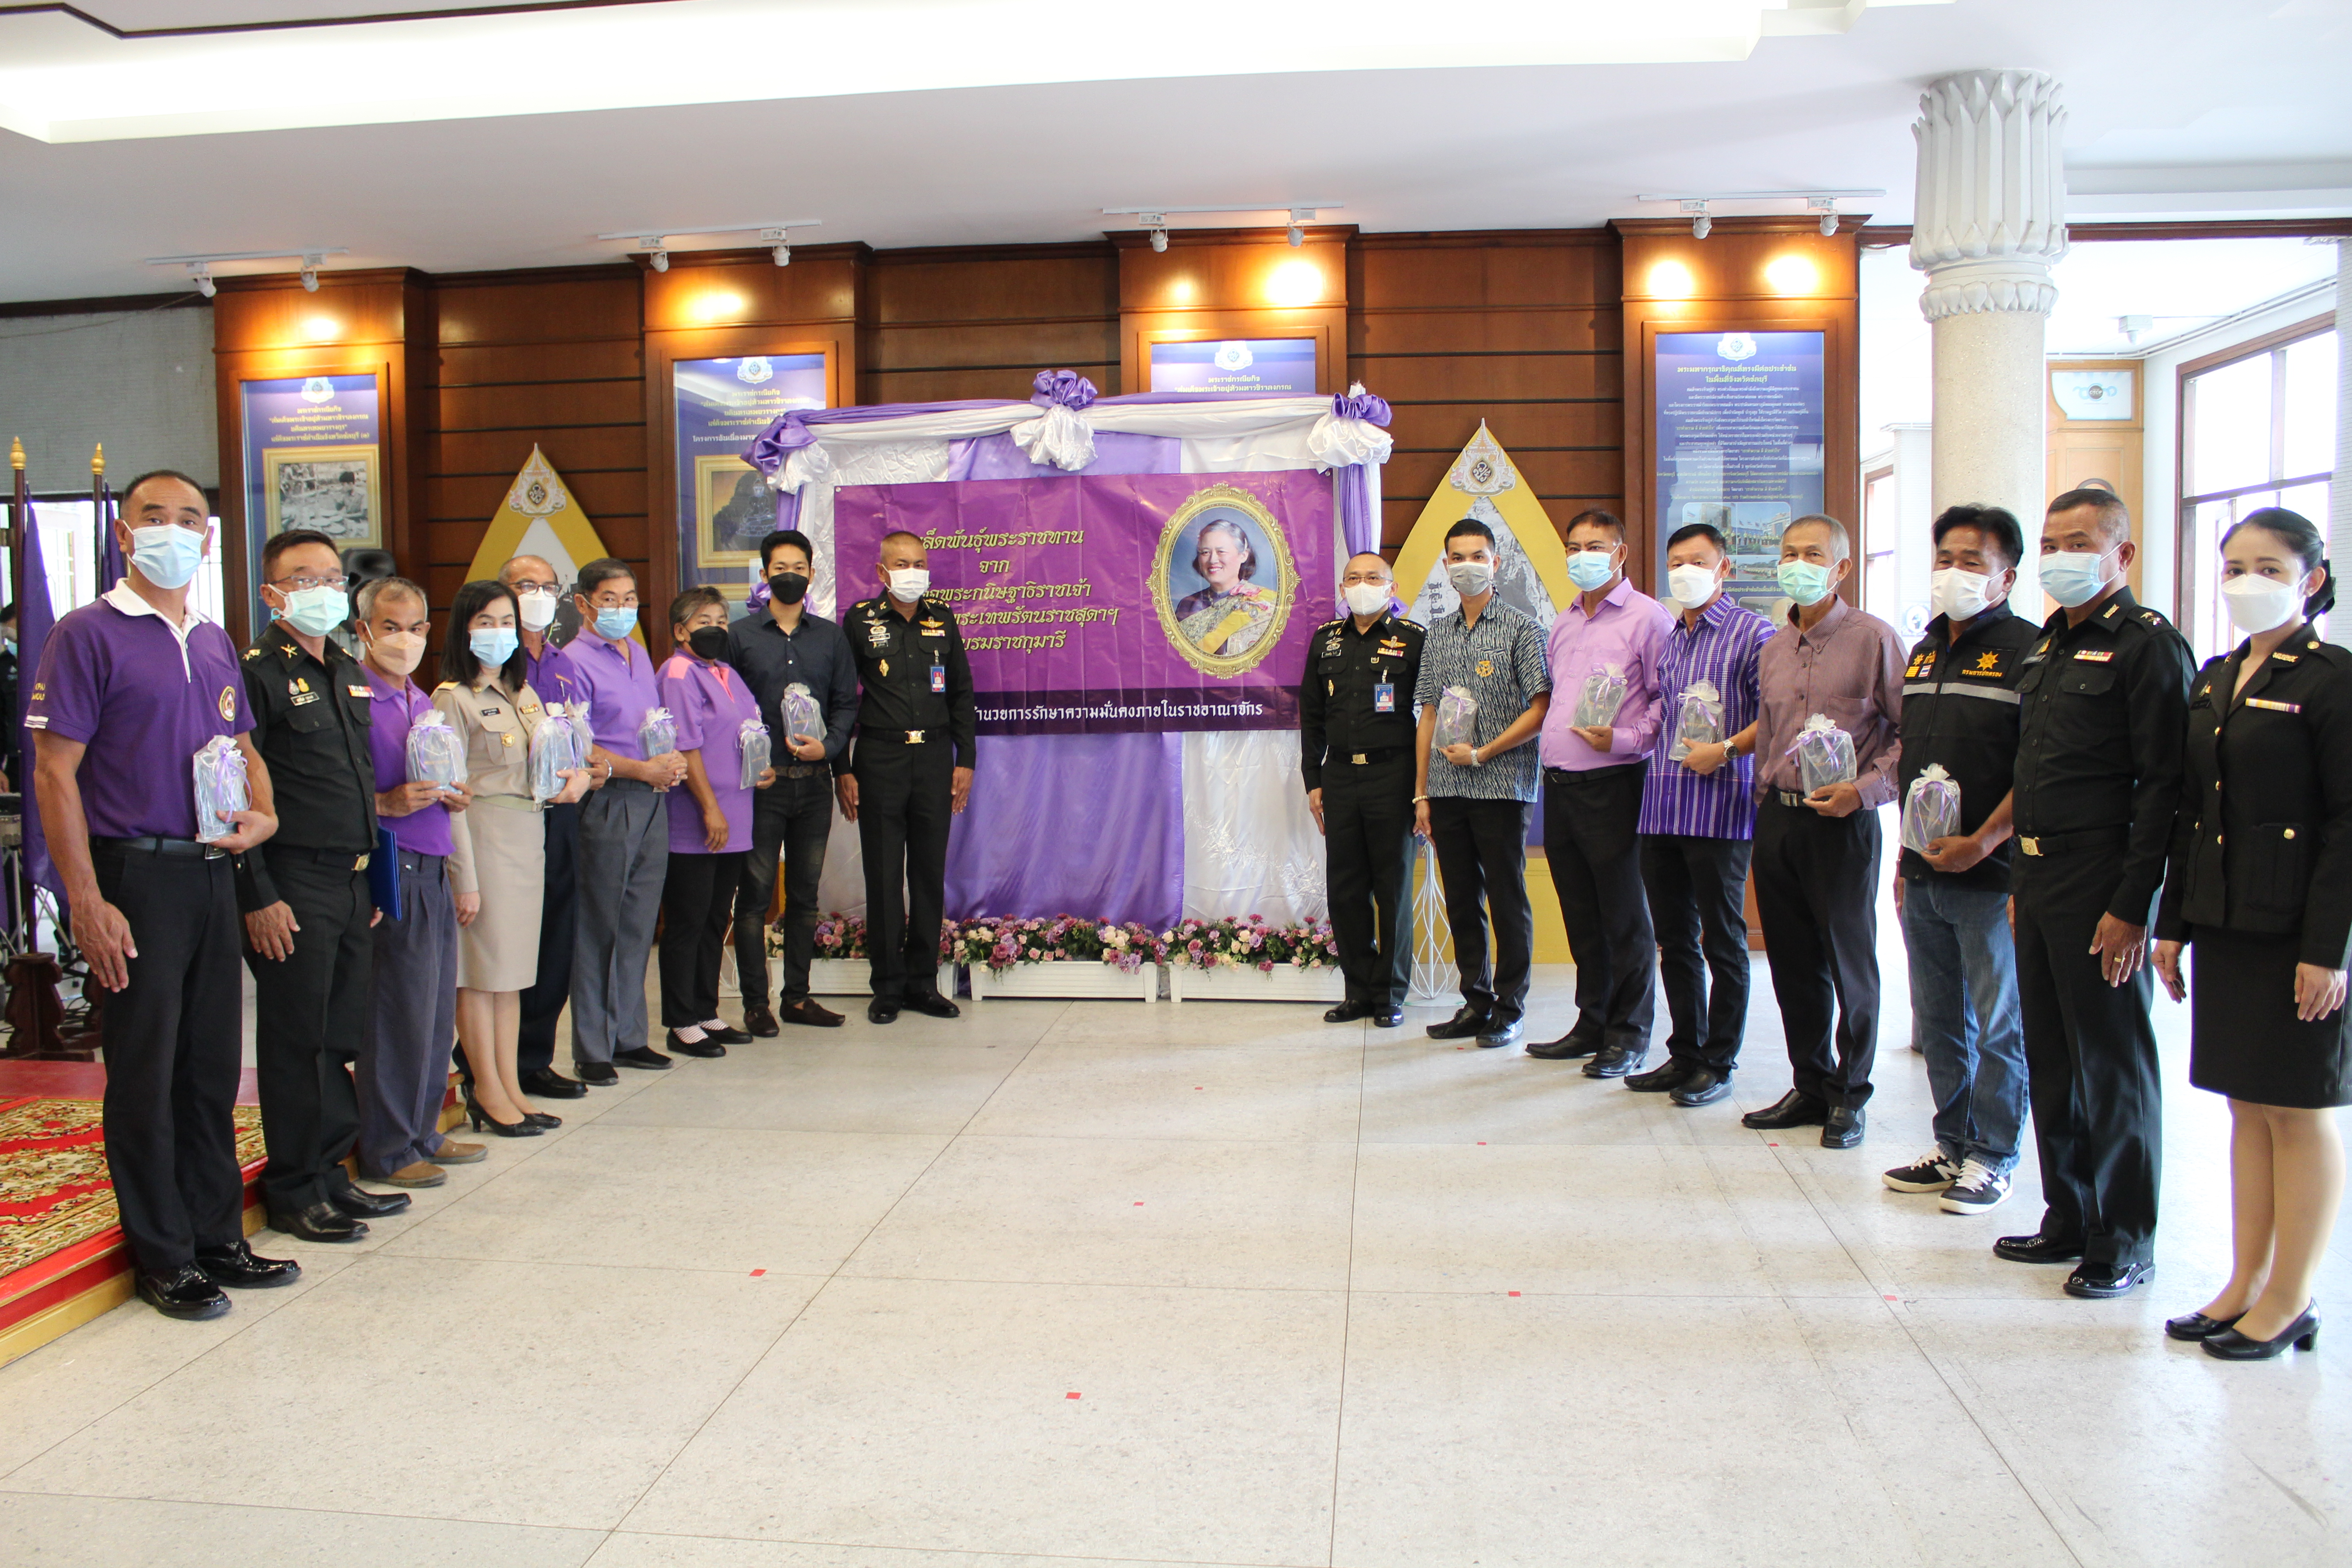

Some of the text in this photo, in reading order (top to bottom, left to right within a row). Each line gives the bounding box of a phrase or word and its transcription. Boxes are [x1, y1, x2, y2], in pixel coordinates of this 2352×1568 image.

[920, 527, 1085, 553] ล็ดพันธุ์พระราชทาน
[979, 559, 1010, 574] จาก
